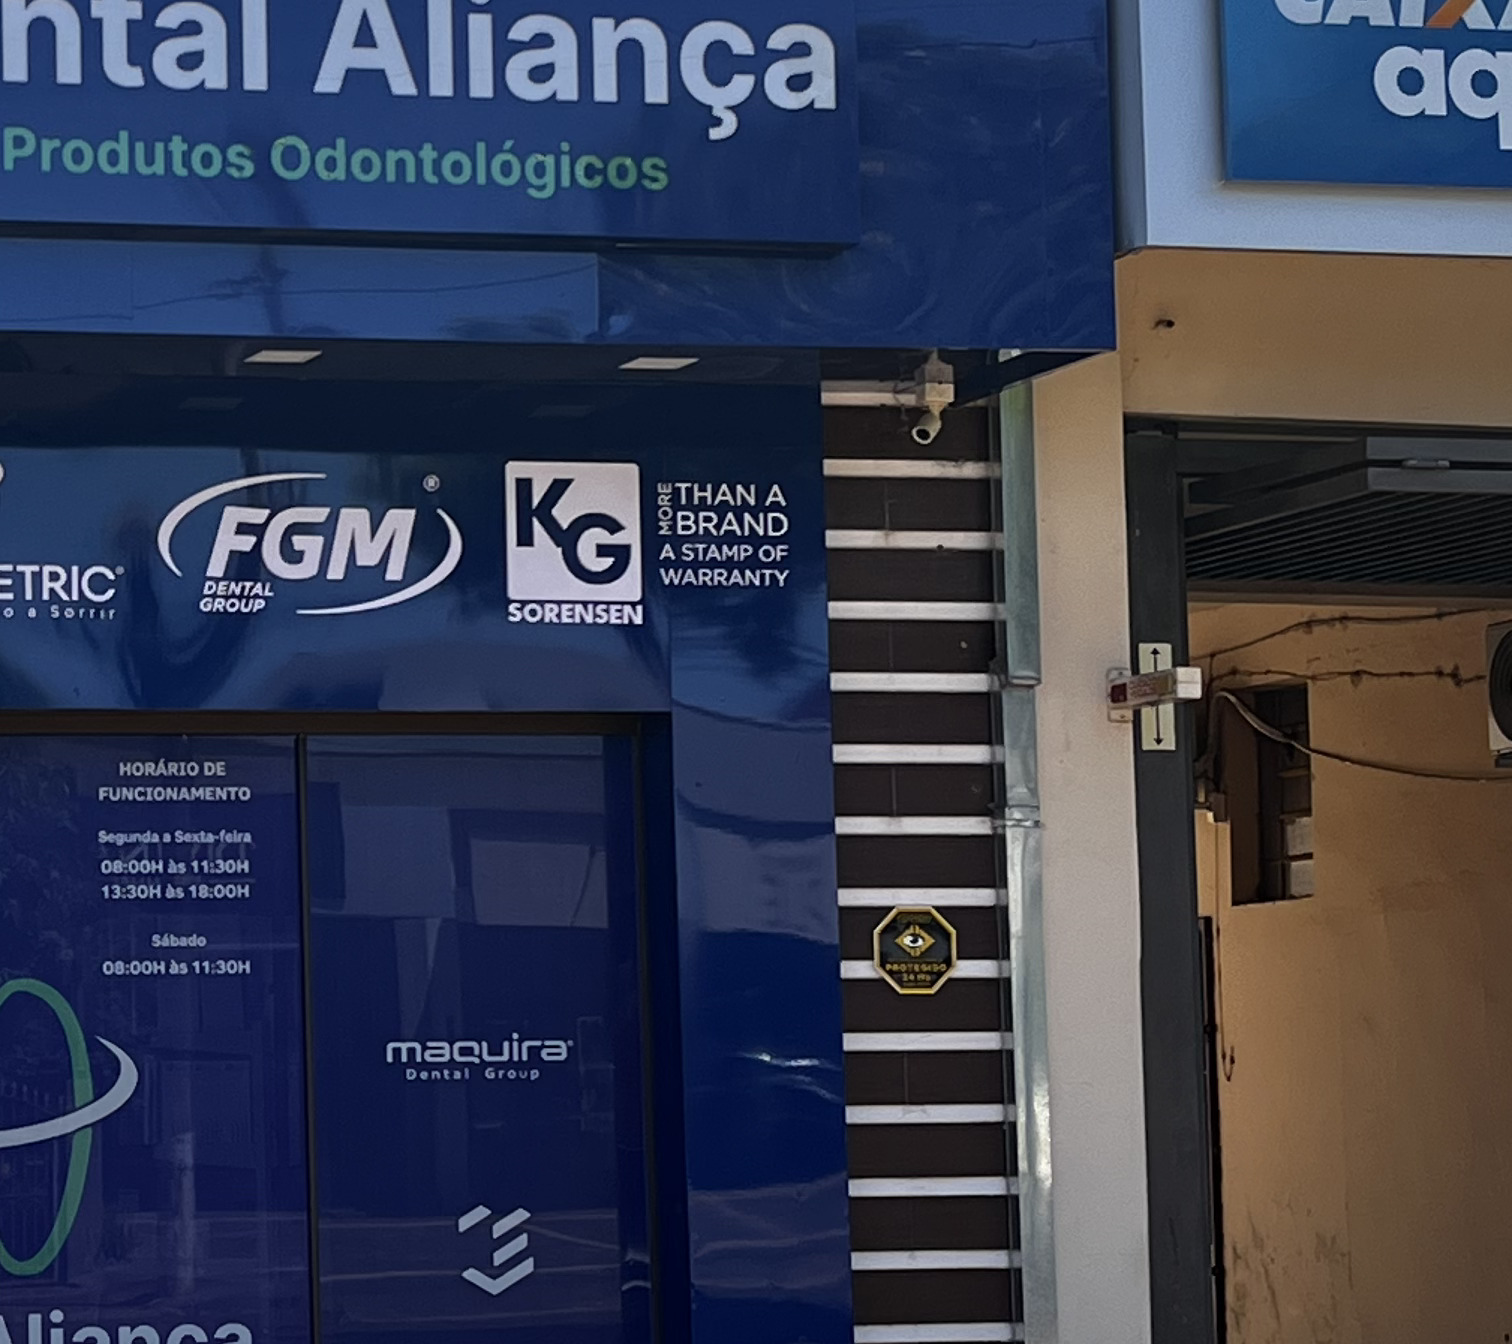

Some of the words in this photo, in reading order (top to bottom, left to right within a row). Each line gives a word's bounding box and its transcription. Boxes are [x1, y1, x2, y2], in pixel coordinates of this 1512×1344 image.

[1374, 46, 1512, 150] aq
[3, 127, 255, 179] Produtos
[270, 135, 668, 199] Odontológicos
[674, 482, 756, 507] THAN
[764, 484, 787, 507] A
[657, 482, 673, 536] MORE
[515, 477, 632, 585] KG
[676, 511, 789, 537] BRAND
[205, 505, 417, 581] FGM
[659, 543, 676, 561] A
[681, 543, 753, 562] STAMP
[758, 544, 789, 562] OF
[659, 568, 790, 587] WARRANTY
[202, 580, 274, 597] DENTAL
[50, 604, 117, 620] Sorrir
[199, 597, 266, 613] GROUP
[507, 602, 643, 625] SORENSEN
[119, 758, 199, 777] HORÁRIO
[203, 761, 227, 776] DE
[98, 786, 251, 802] FUNCIONAMENTO
[98, 830, 160, 846] Segunda
[162, 832, 172, 843] a
[174, 829, 252, 844] Sexta-feira
[100, 859, 164, 874] 08:00H
[167, 858, 187, 874] às
[190, 859, 250, 874] 11:30H
[101, 884, 162, 899] 13:30H
[165, 883, 185, 899] às
[188, 884, 250, 899] 18:00H
[151, 933, 207, 947] Sábado
[102, 960, 166, 976] 08:00H
[168, 959, 189, 975] às
[192, 960, 251, 975] 11:30H
[386, 1032, 569, 1064] maquira
[405, 1067, 470, 1081] Dental
[484, 1067, 540, 1081] Group
